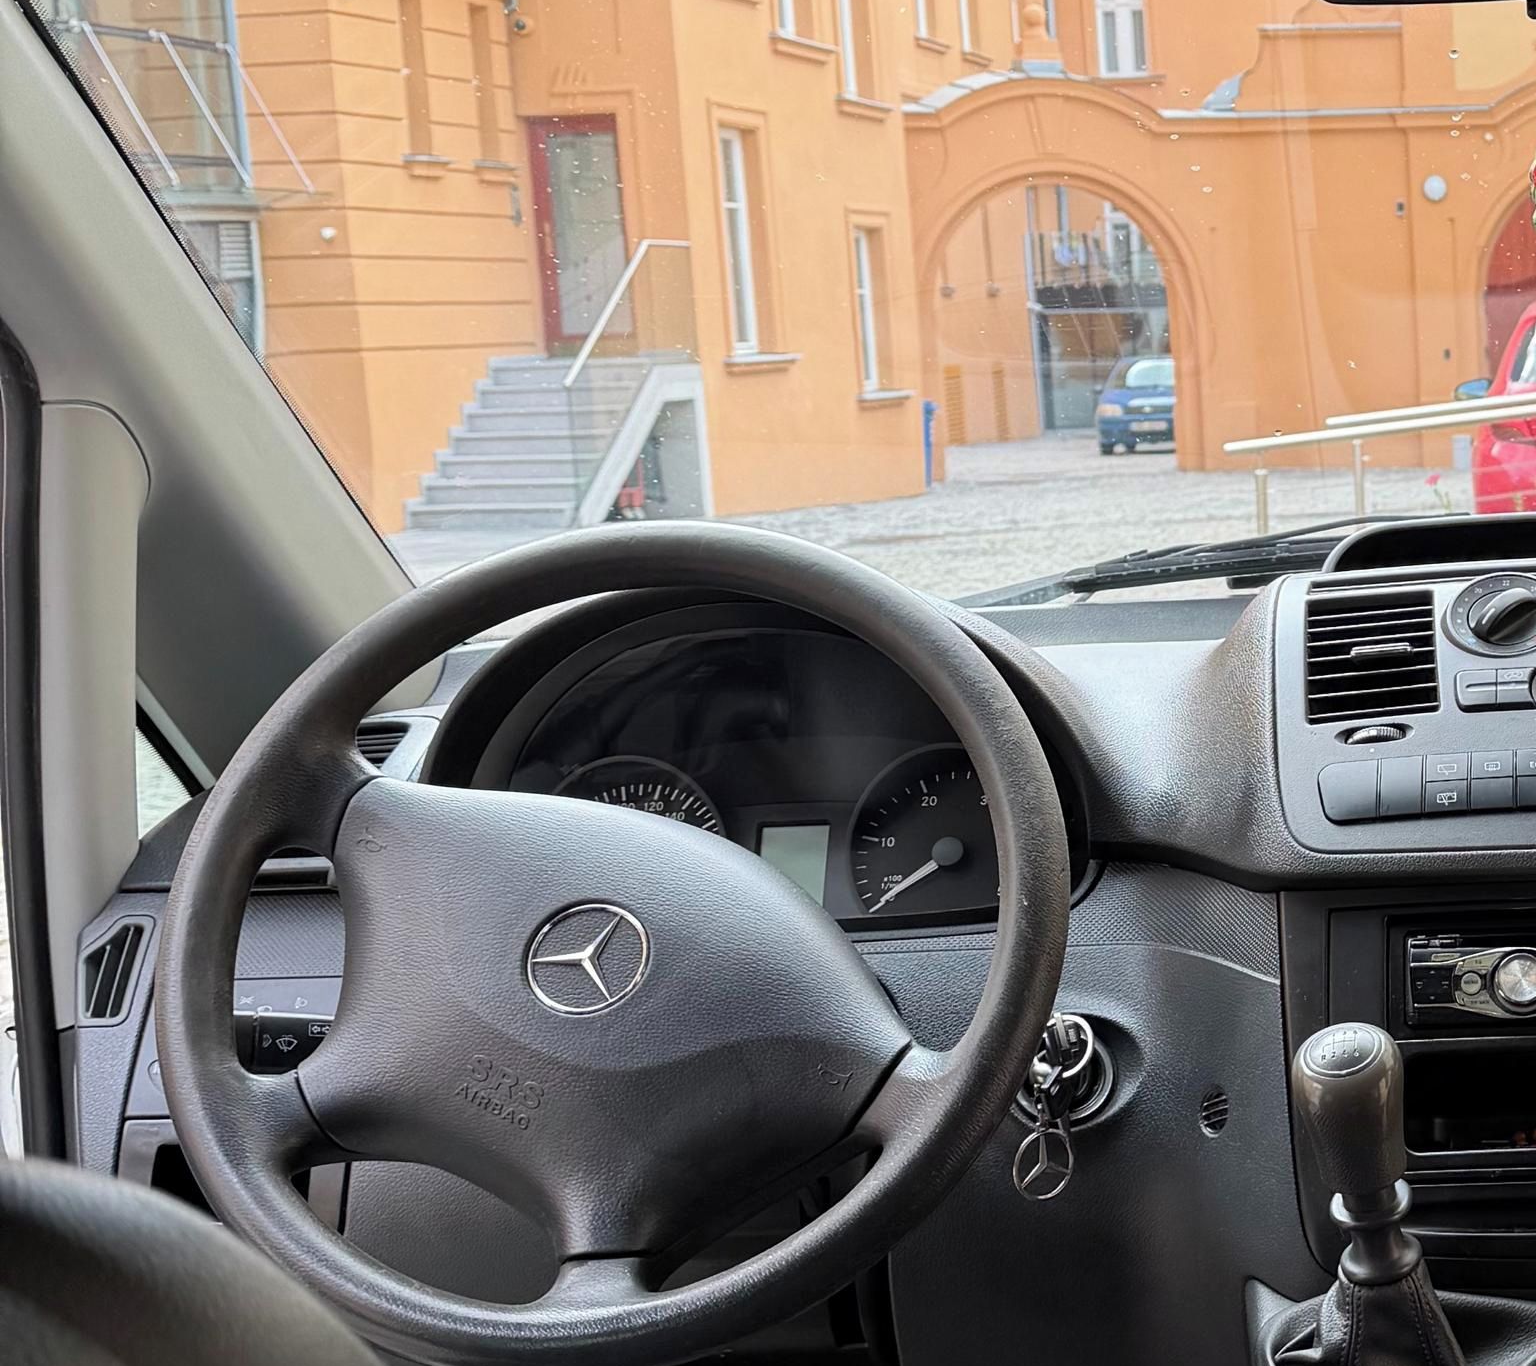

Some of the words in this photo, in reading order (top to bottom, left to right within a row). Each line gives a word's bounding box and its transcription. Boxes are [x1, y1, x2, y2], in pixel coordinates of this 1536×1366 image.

[643, 801, 665, 812] 120
[921, 796, 938, 807] 20
[880, 837, 896, 848] 10
[465, 1054, 545, 1110] SRS
[453, 1082, 531, 1131] AIRBAG
